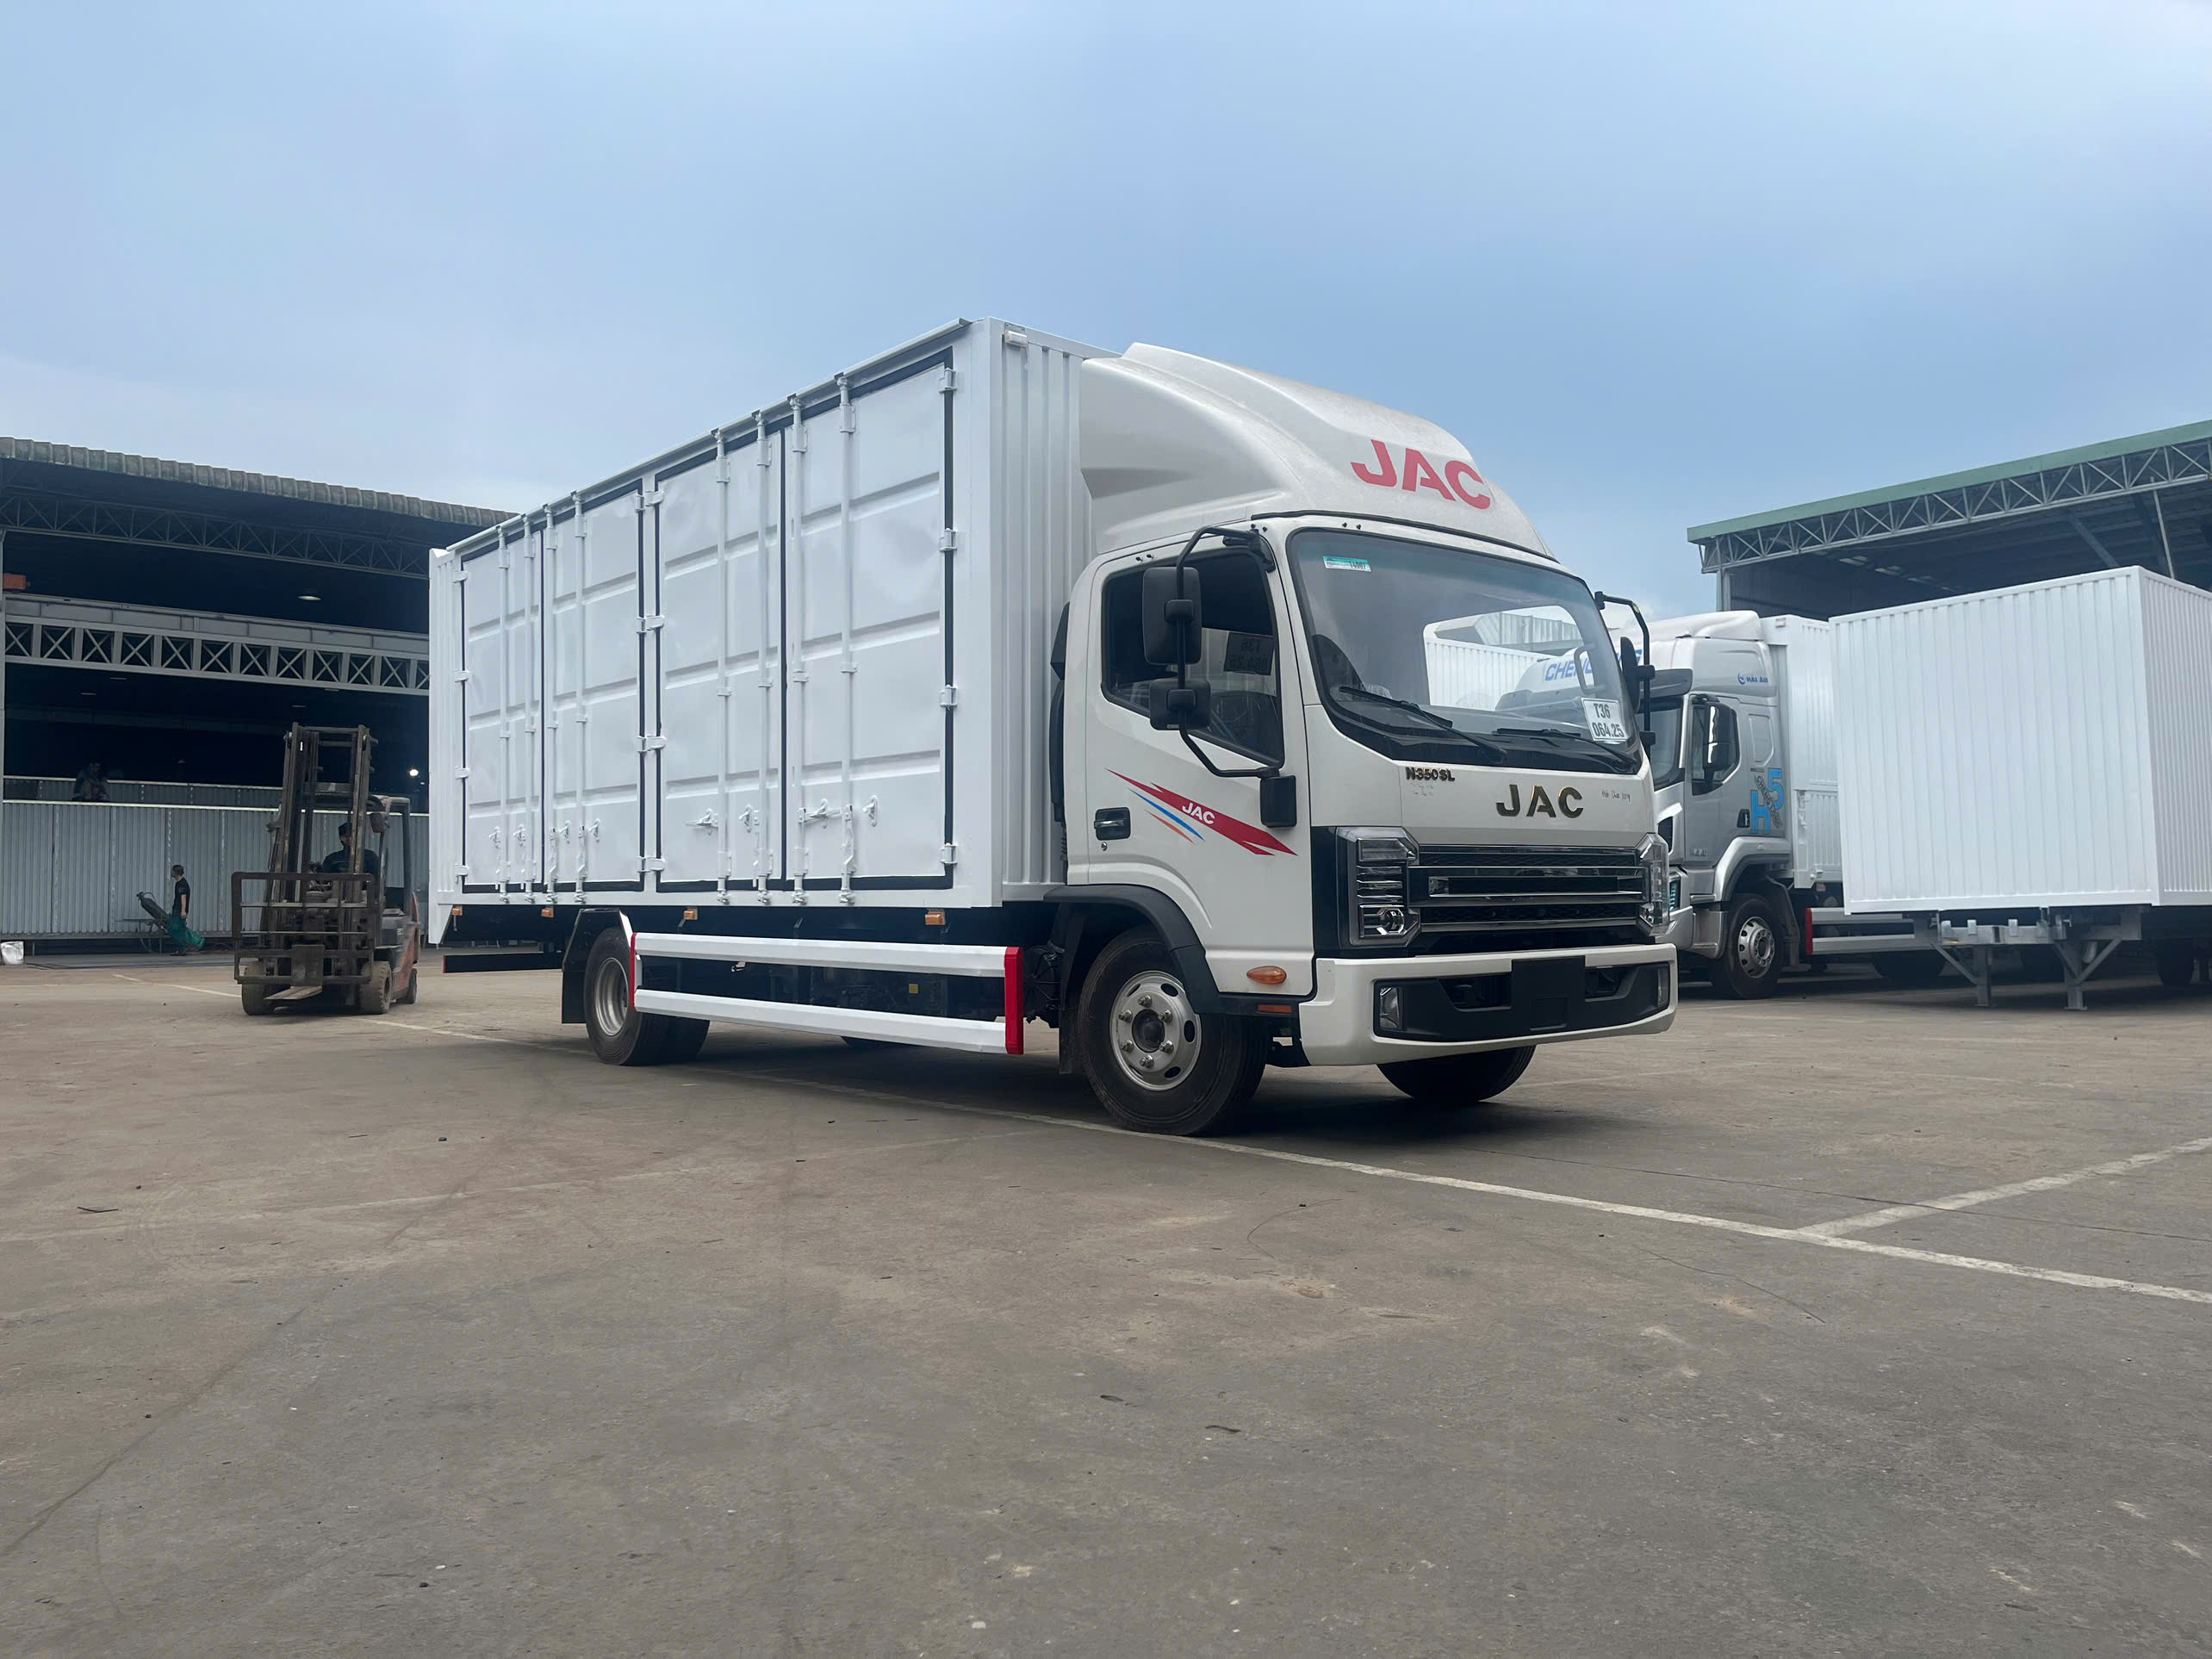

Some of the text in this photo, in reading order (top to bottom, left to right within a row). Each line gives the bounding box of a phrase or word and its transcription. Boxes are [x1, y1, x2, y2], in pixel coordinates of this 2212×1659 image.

[1351, 439, 1490, 510] JAC
[1594, 703, 1611, 718] T36
[1592, 723, 1625, 738] 064.25
[1406, 767, 1456, 781] N350SL
[1495, 784, 1584, 819] JAC
[1182, 801, 1215, 825] JAC
